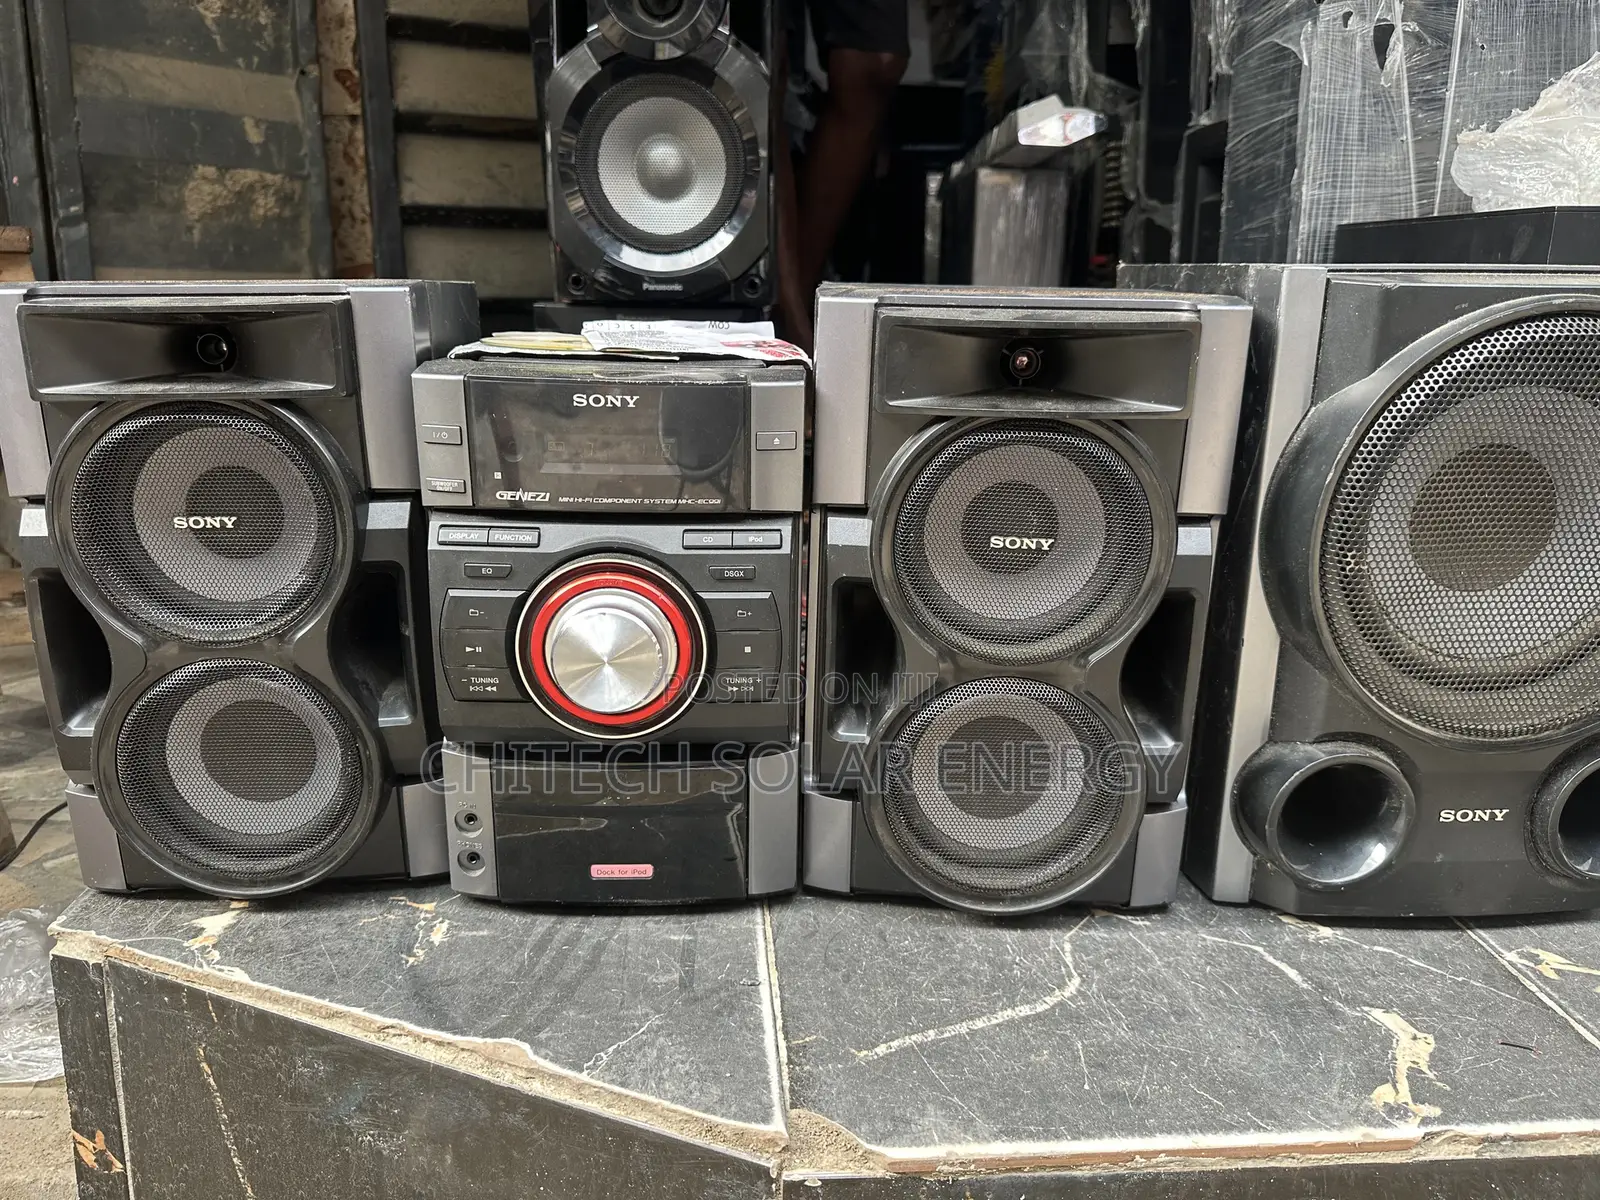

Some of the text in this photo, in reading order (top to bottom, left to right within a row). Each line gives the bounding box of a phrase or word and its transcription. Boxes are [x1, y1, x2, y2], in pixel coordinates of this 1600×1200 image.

[642, 283, 684, 291] Panasonic
[572, 393, 640, 408] SONY
[495, 488, 550, 502] GENEZI
[173, 515, 238, 529] SONY
[448, 532, 480, 540] DISPLAY
[494, 534, 533, 542] FUNCTION
[990, 535, 1055, 551] SONY
[481, 567, 493, 575] EQ
[1440, 809, 1510, 822] SONY
